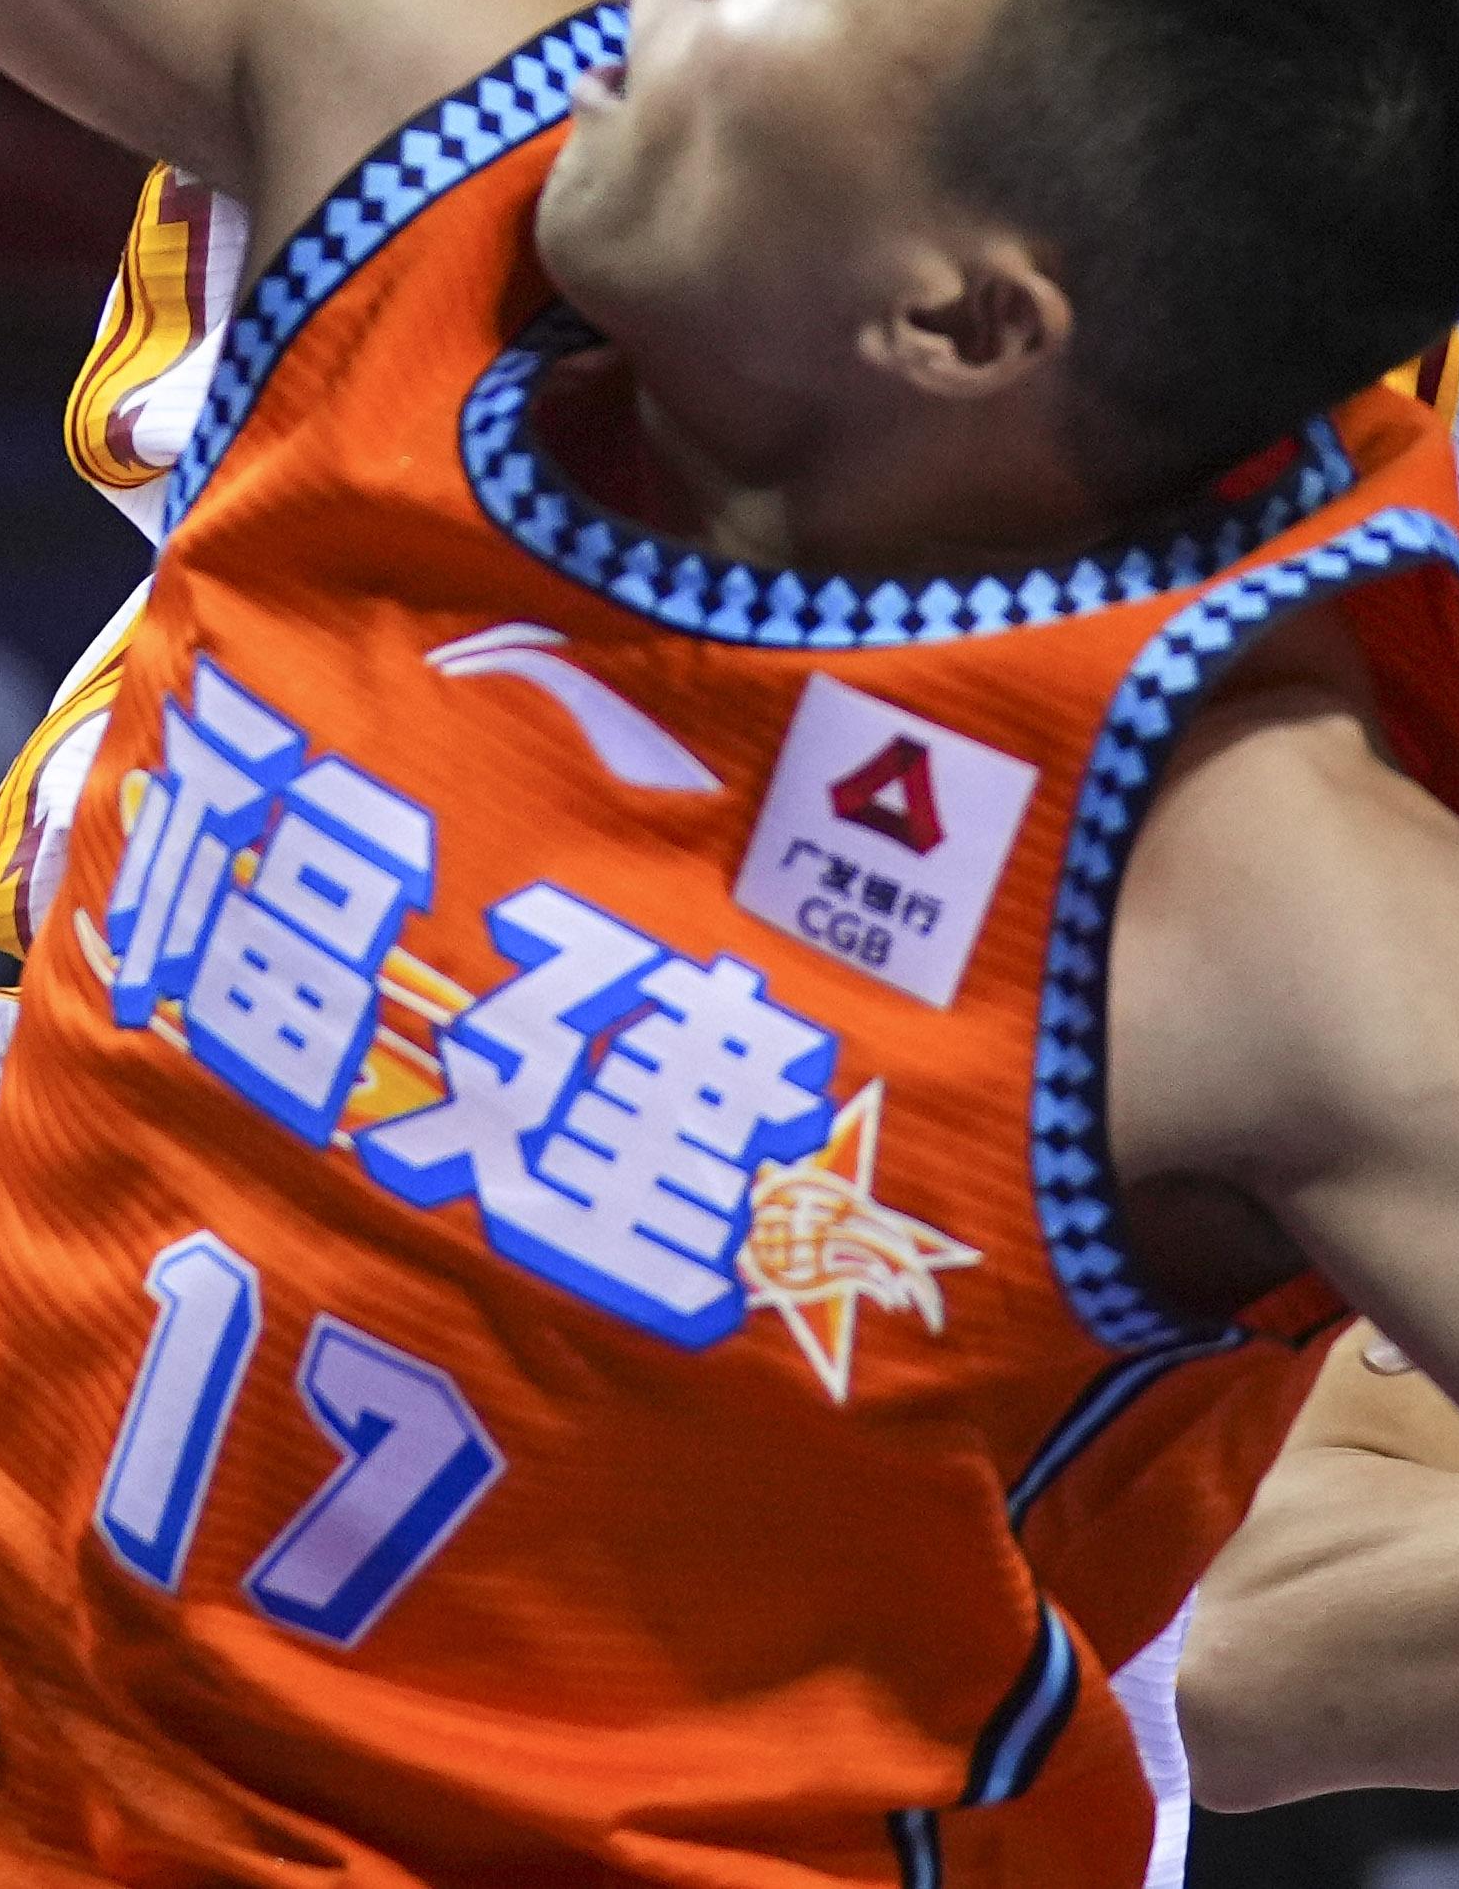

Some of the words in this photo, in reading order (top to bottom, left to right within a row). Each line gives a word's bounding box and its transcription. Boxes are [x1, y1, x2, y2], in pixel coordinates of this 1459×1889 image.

[110, 652, 838, 1352] 福建
[796, 895, 895, 968] CGB
[94, 1227, 506, 1649] 17
